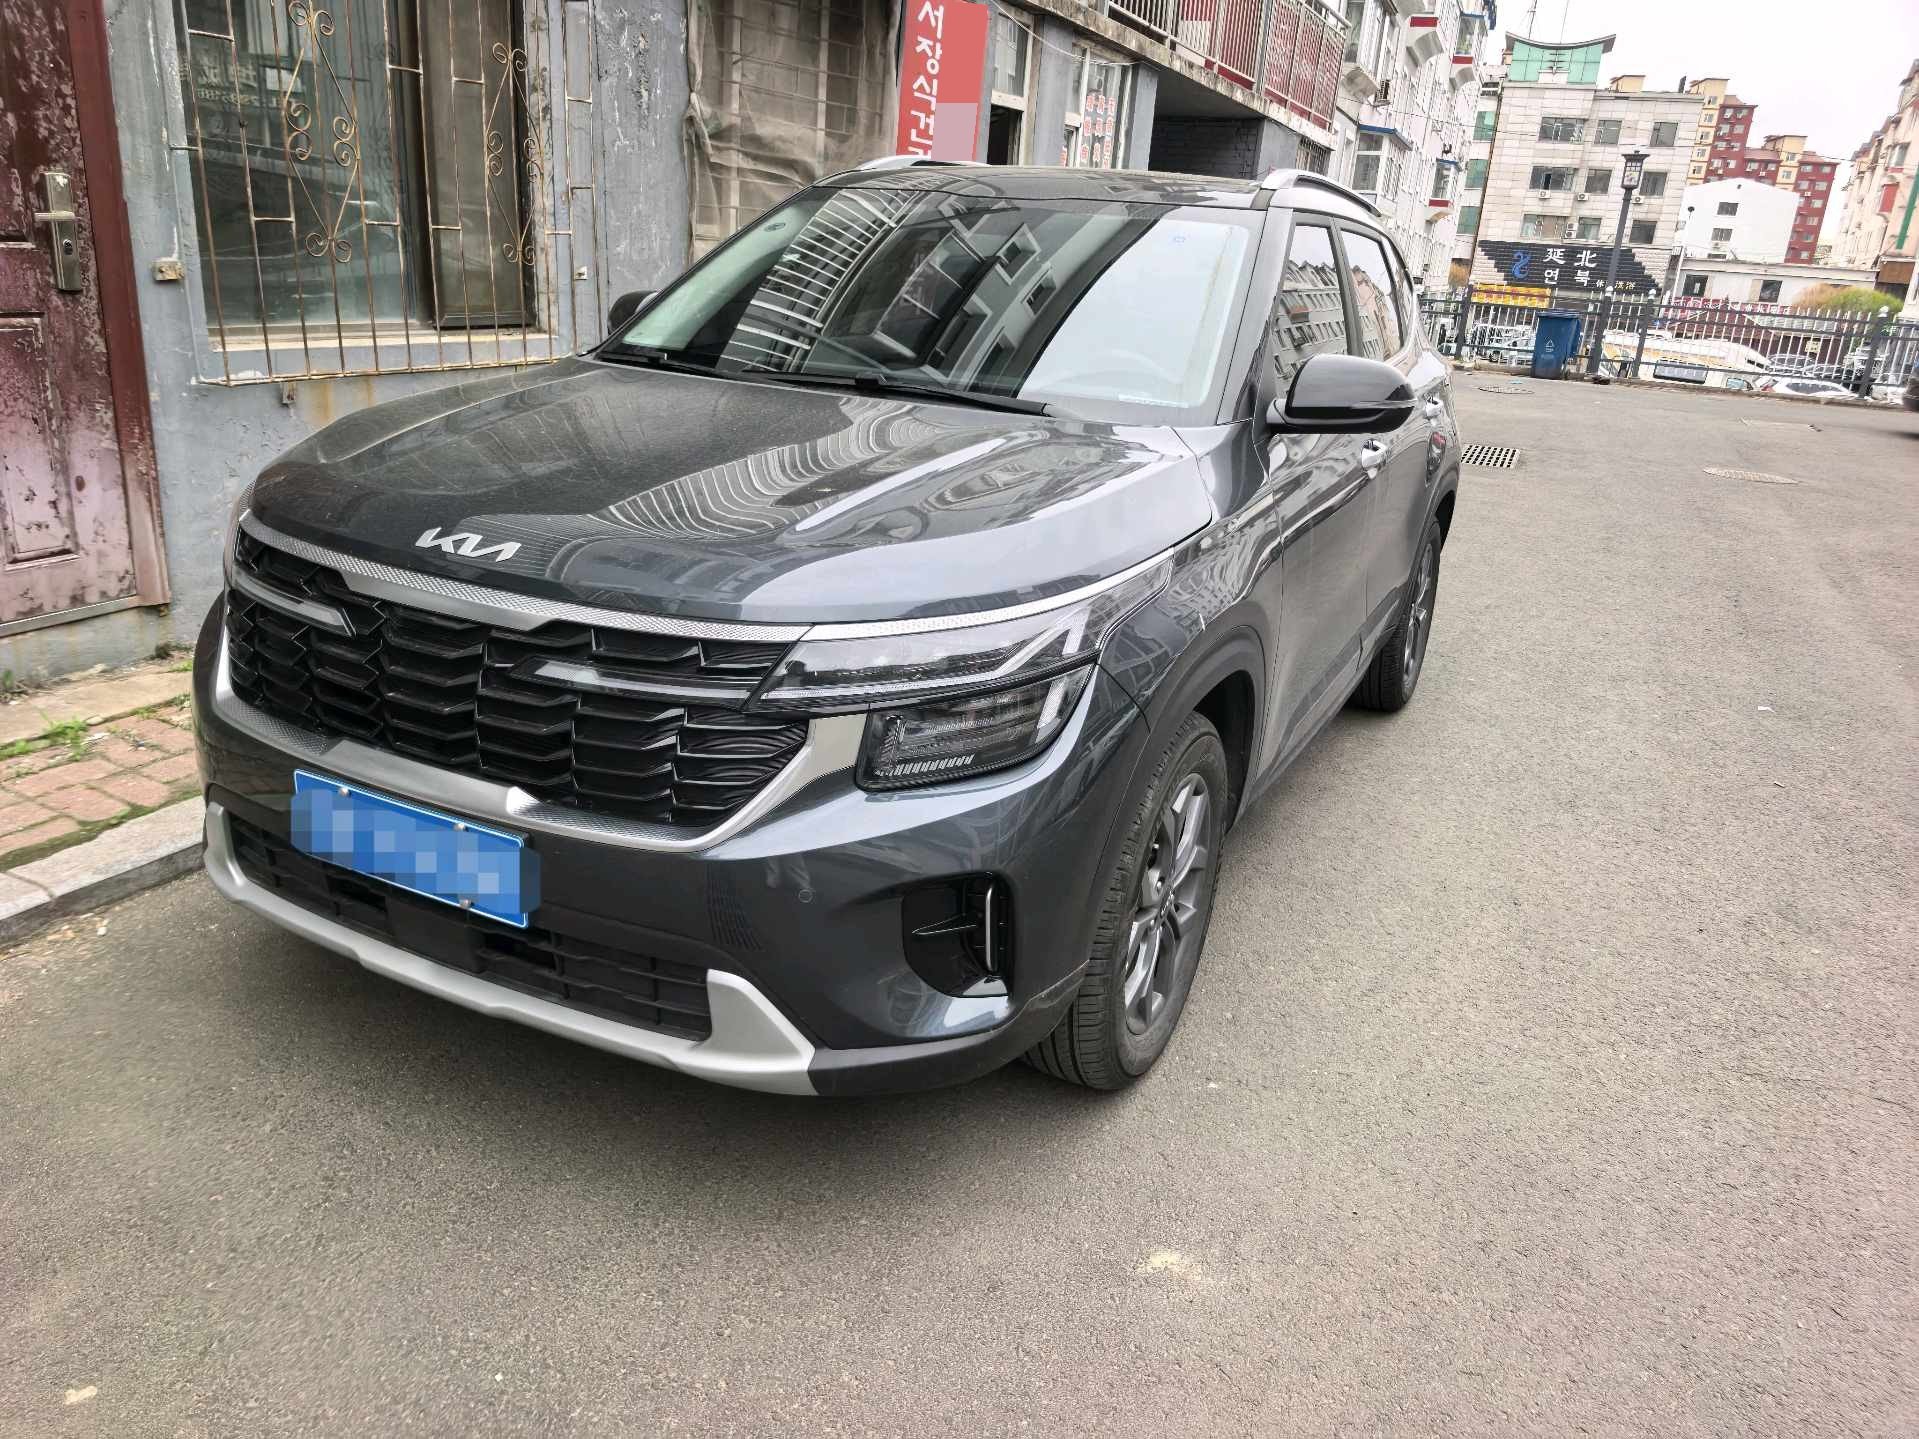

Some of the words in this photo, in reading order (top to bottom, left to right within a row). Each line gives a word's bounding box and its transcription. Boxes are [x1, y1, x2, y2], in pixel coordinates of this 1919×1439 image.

[1543, 247, 1598, 268] 延北
[1543, 267, 1592, 287] 연북
[415, 526, 522, 562] KIA
